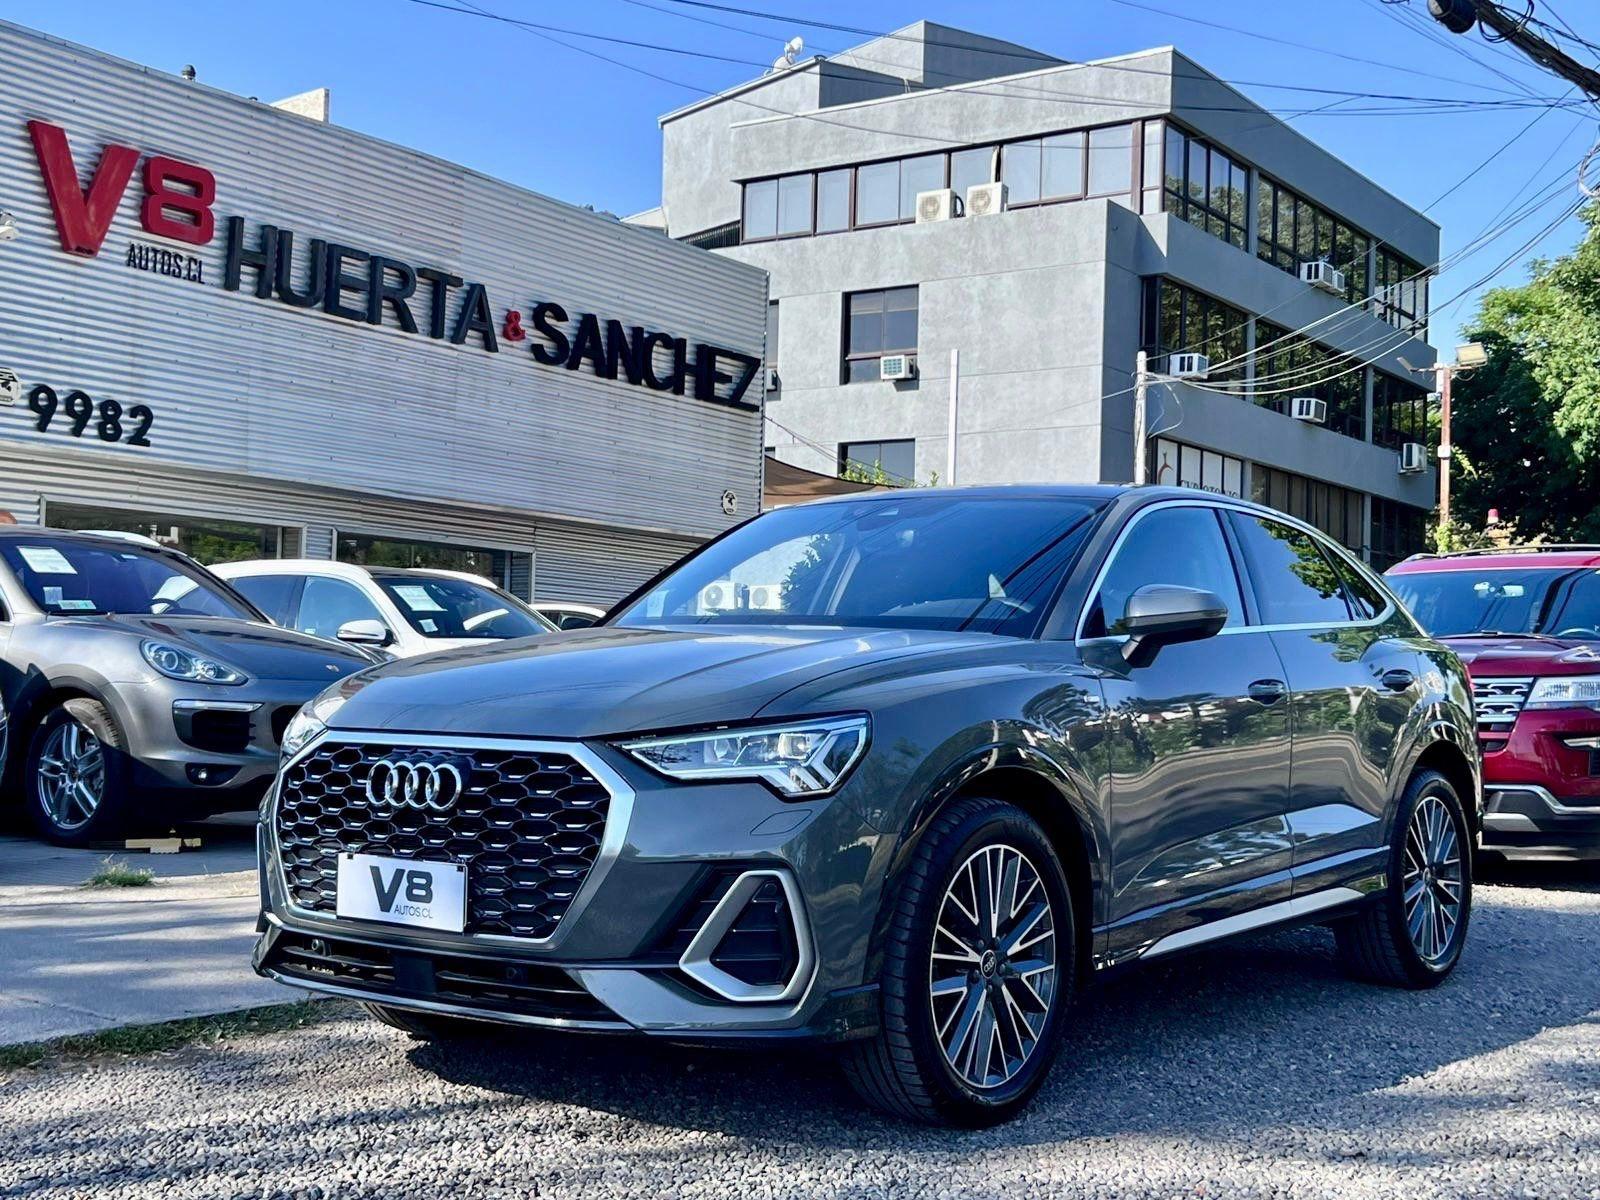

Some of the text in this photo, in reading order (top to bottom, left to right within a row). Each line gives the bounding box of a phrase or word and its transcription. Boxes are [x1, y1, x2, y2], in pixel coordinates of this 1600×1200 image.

[27, 119, 216, 258] V8
[127, 243, 206, 285] AUTOS.CL
[224, 215, 762, 413] HUERTA & SANCHEZ
[29, 384, 153, 447] 9982
[369, 865, 433, 913] V8
[393, 903, 433, 919] AUTOS.CL
